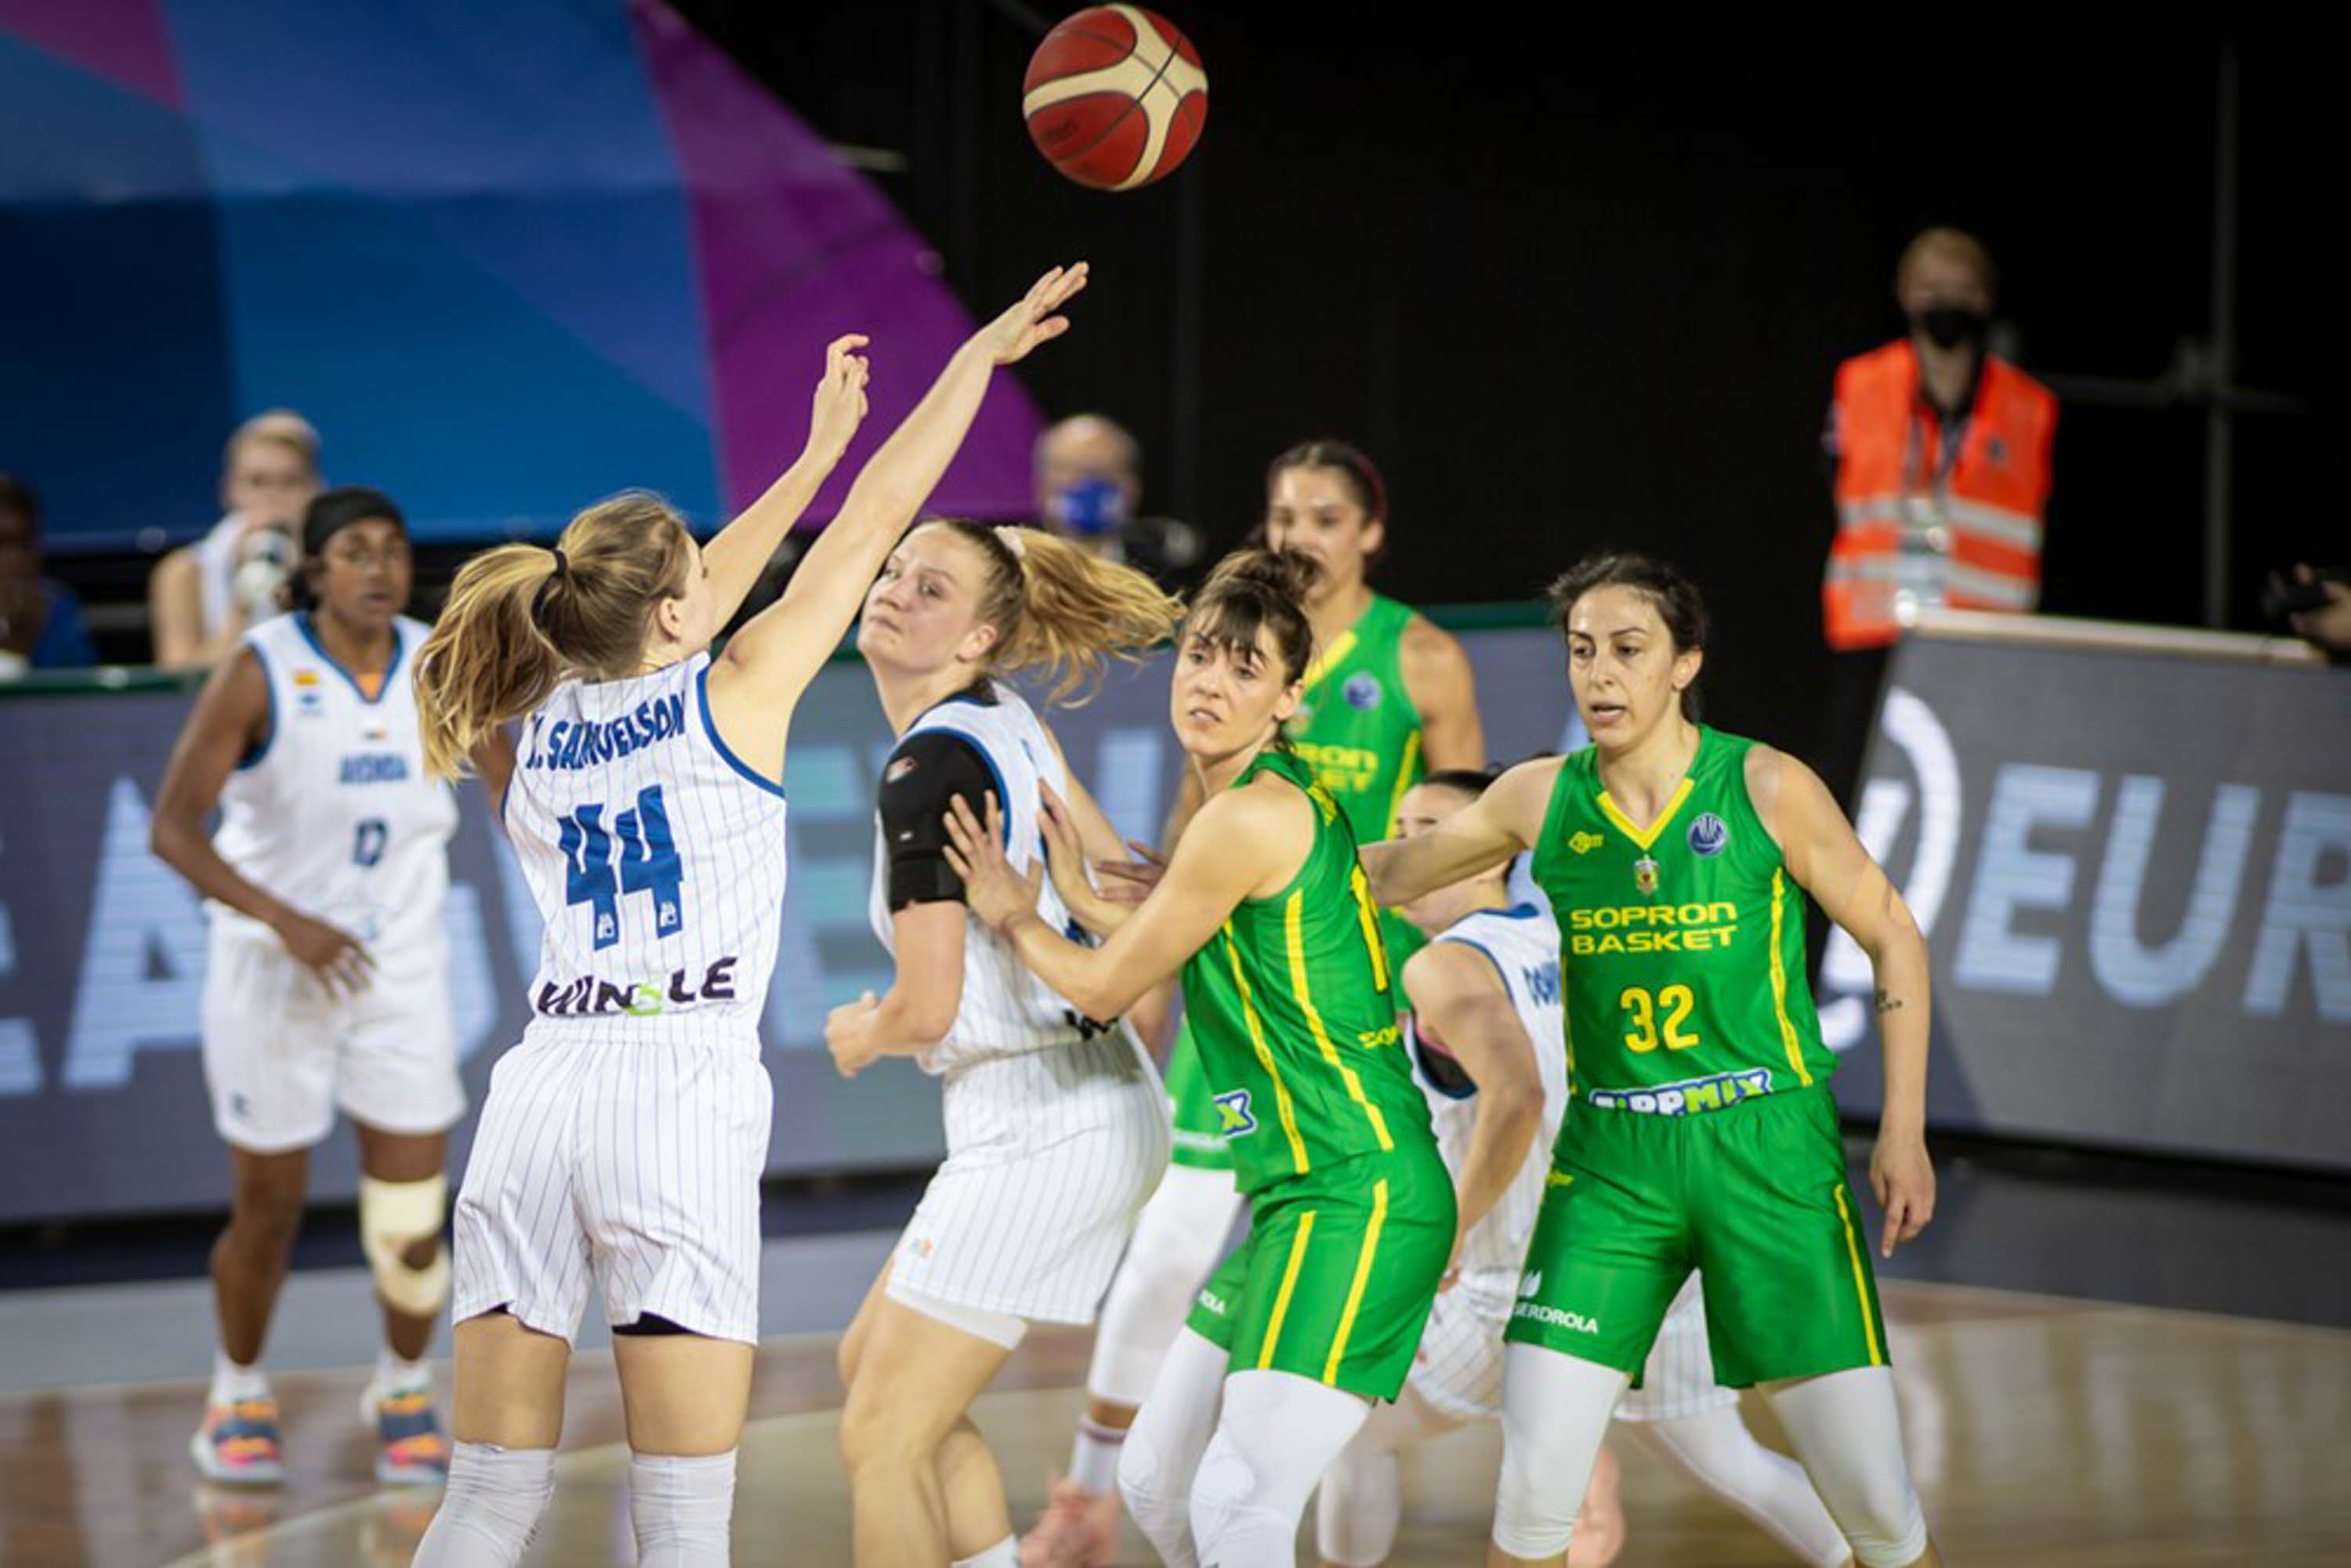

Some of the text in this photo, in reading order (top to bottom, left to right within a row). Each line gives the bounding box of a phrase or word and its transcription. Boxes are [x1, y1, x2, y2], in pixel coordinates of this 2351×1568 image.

[547, 689, 686, 771] SAMUELSON
[557, 784, 684, 952] 44
[1953, 760, 2351, 1025] EUR
[1570, 902, 1738, 931] SOPRON
[1571, 925, 1738, 956] BASKET
[1620, 984, 1700, 1054] 32
